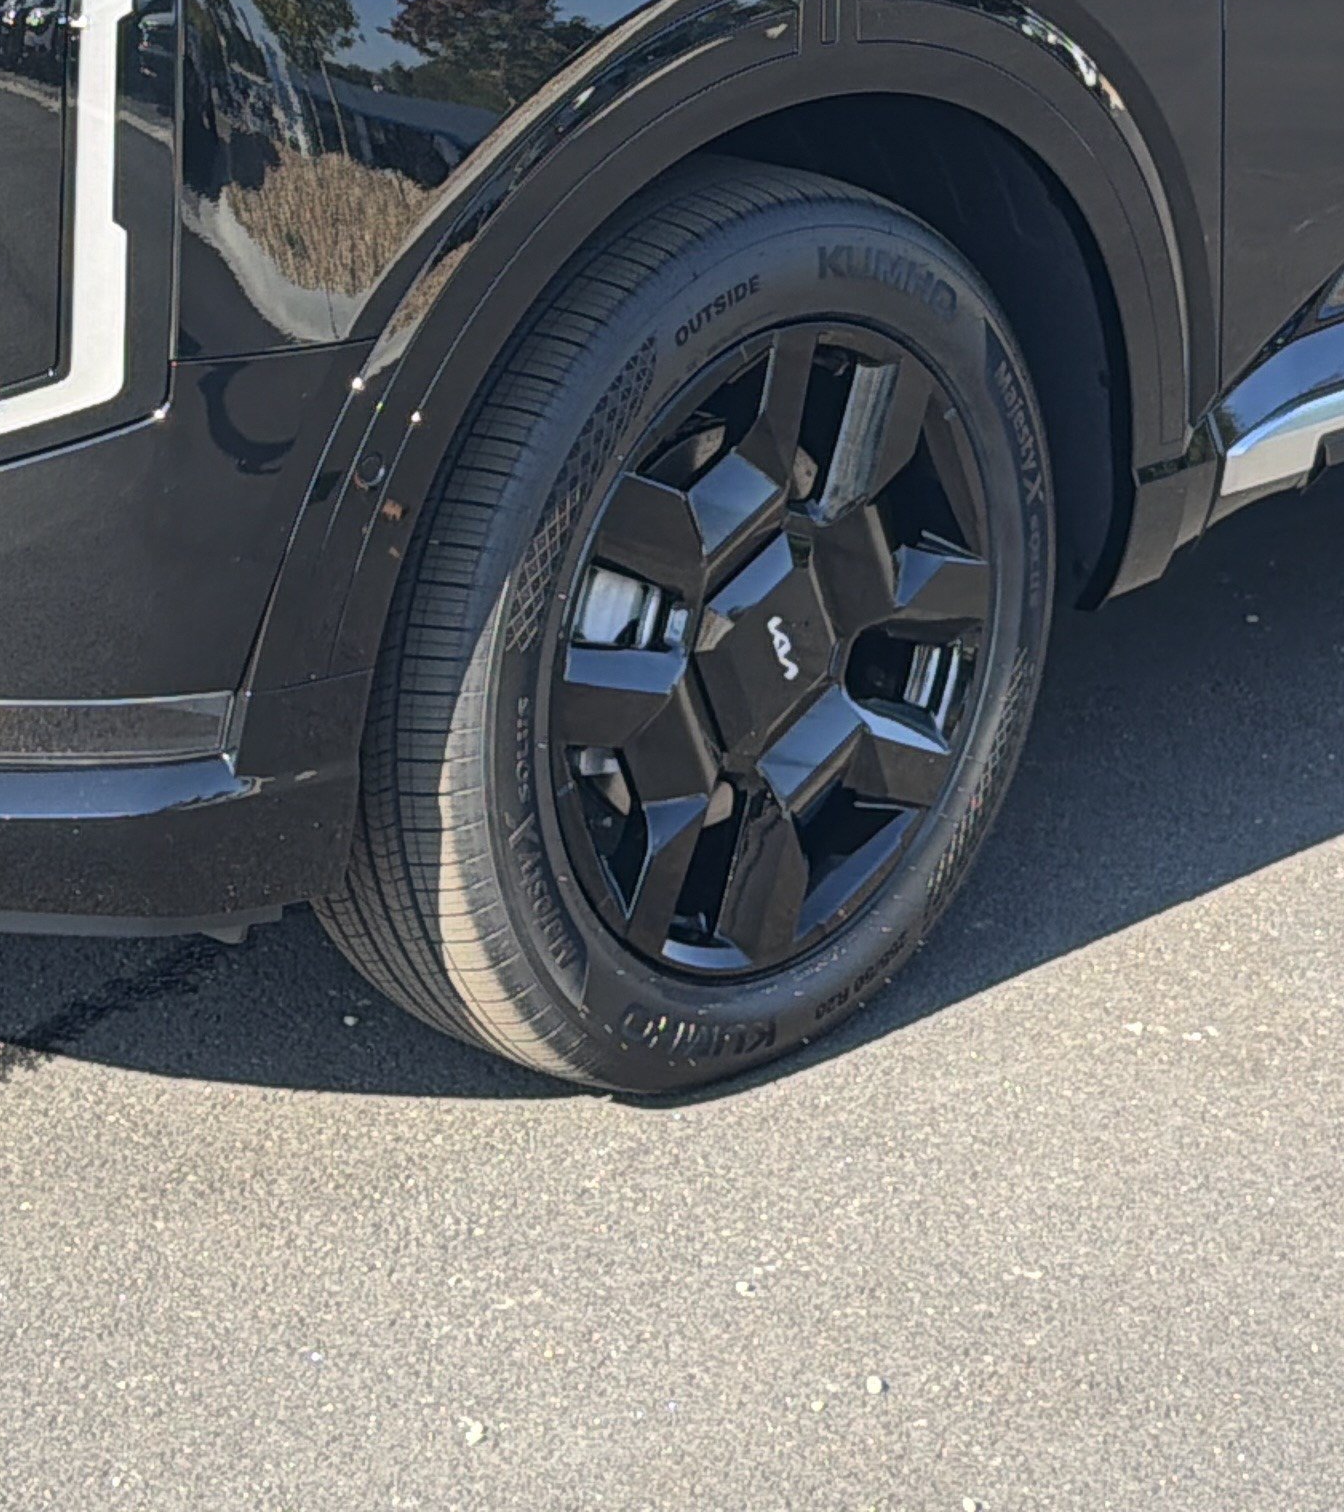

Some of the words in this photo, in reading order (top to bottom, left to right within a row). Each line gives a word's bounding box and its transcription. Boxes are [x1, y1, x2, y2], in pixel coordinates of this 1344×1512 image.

[674, 273, 761, 347] OUTSIDE
[816, 244, 957, 322] KUMHO
[993, 360, 1038, 472] Majesty
